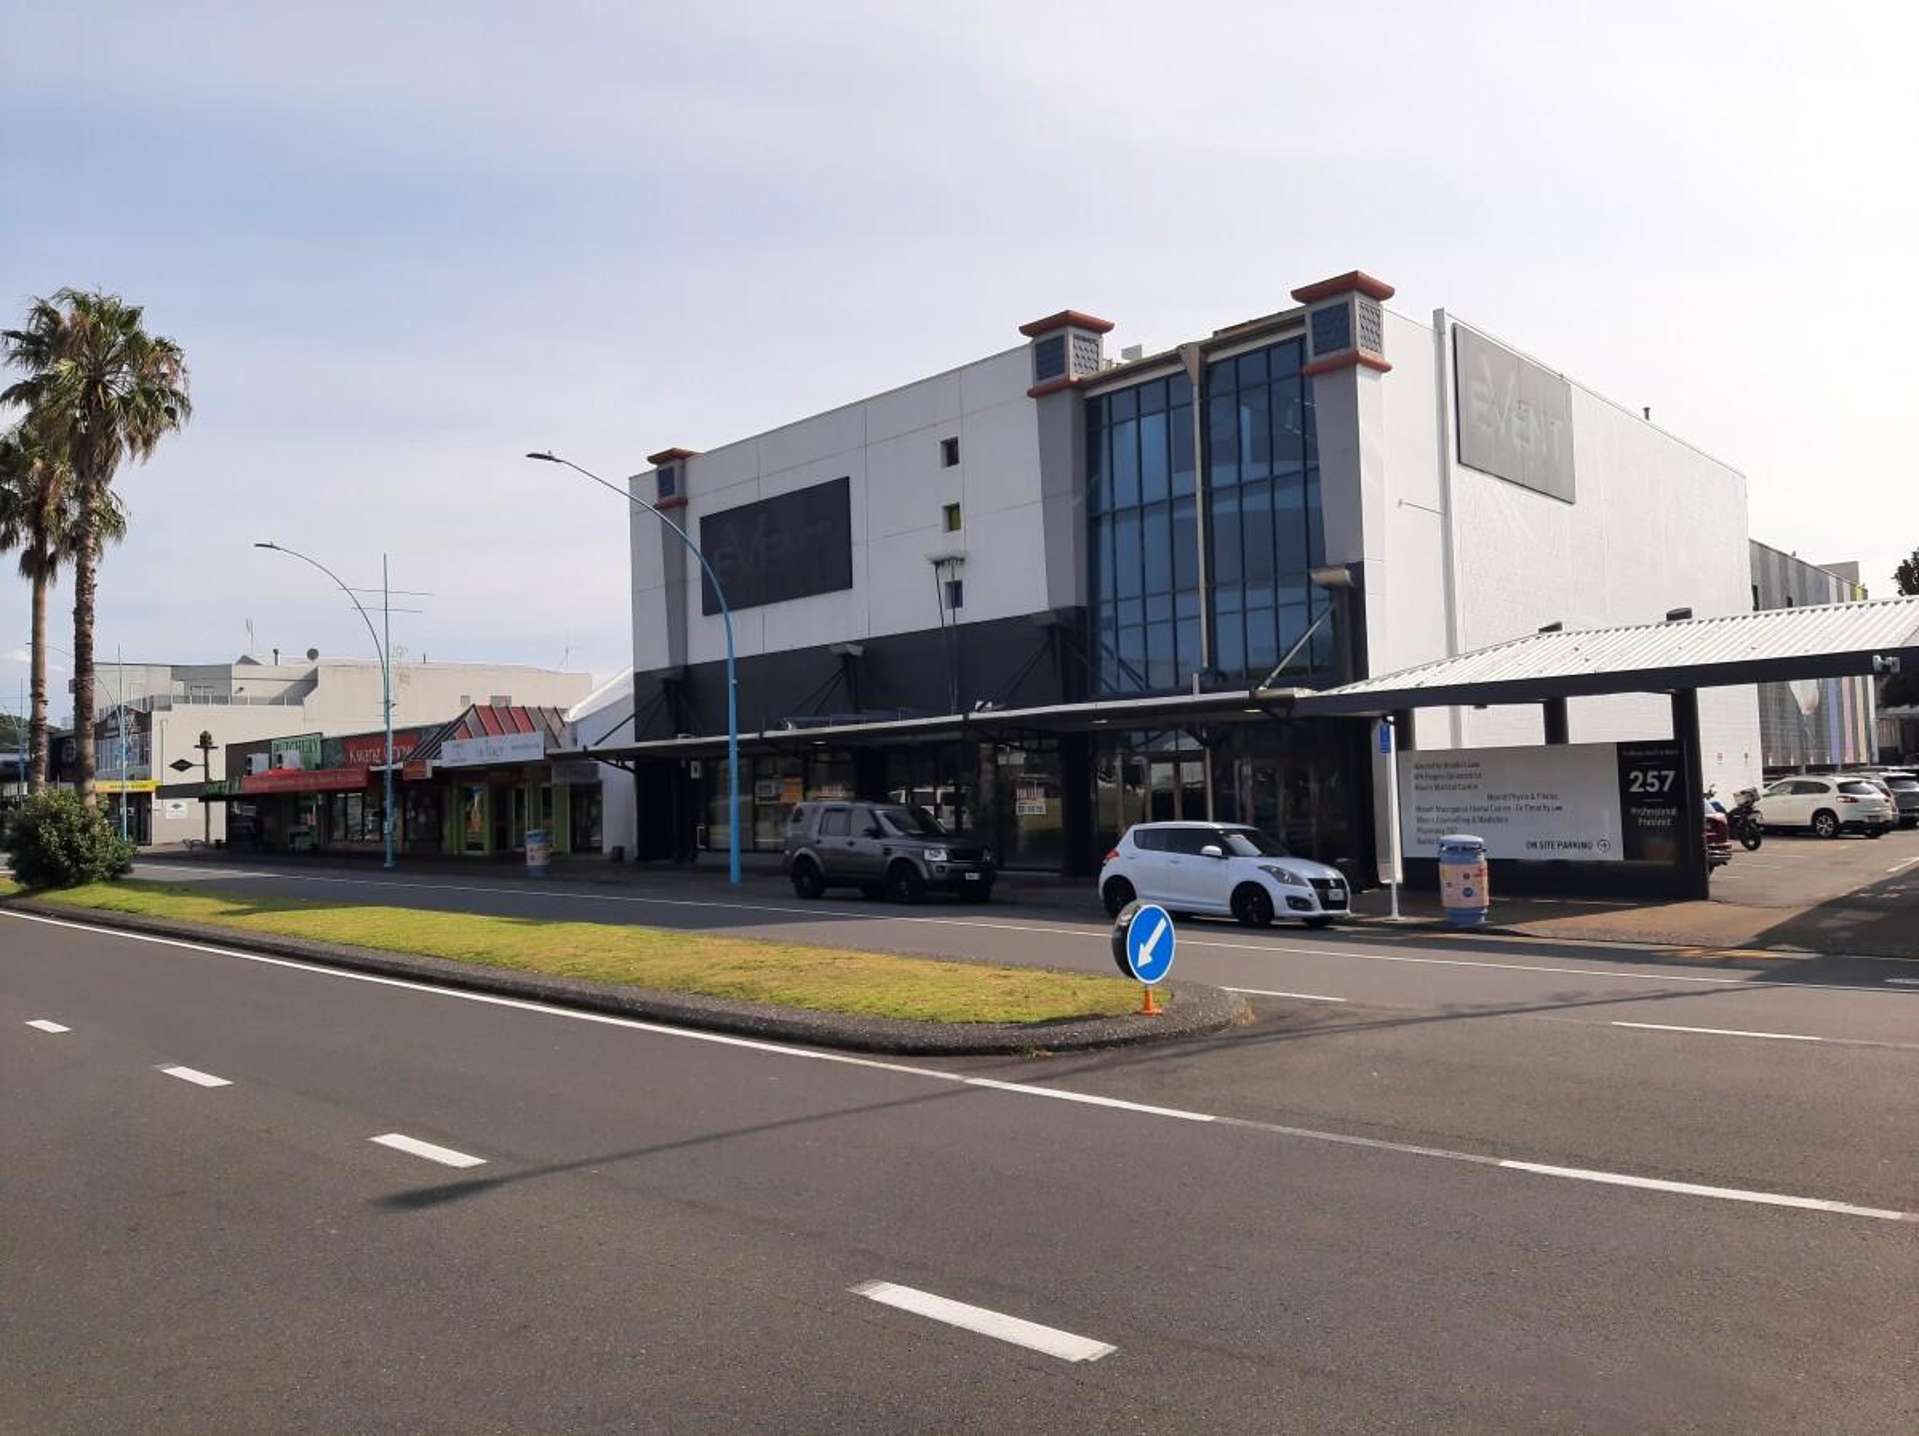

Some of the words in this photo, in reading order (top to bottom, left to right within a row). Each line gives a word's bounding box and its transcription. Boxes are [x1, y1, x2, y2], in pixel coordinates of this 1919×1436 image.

[1470, 353, 1565, 463] EVENT
[1629, 770, 1677, 793] 257
[1525, 840, 1538, 850] ON
[1539, 840, 1557, 850] SITE
[1558, 840, 1593, 850] PARKING
